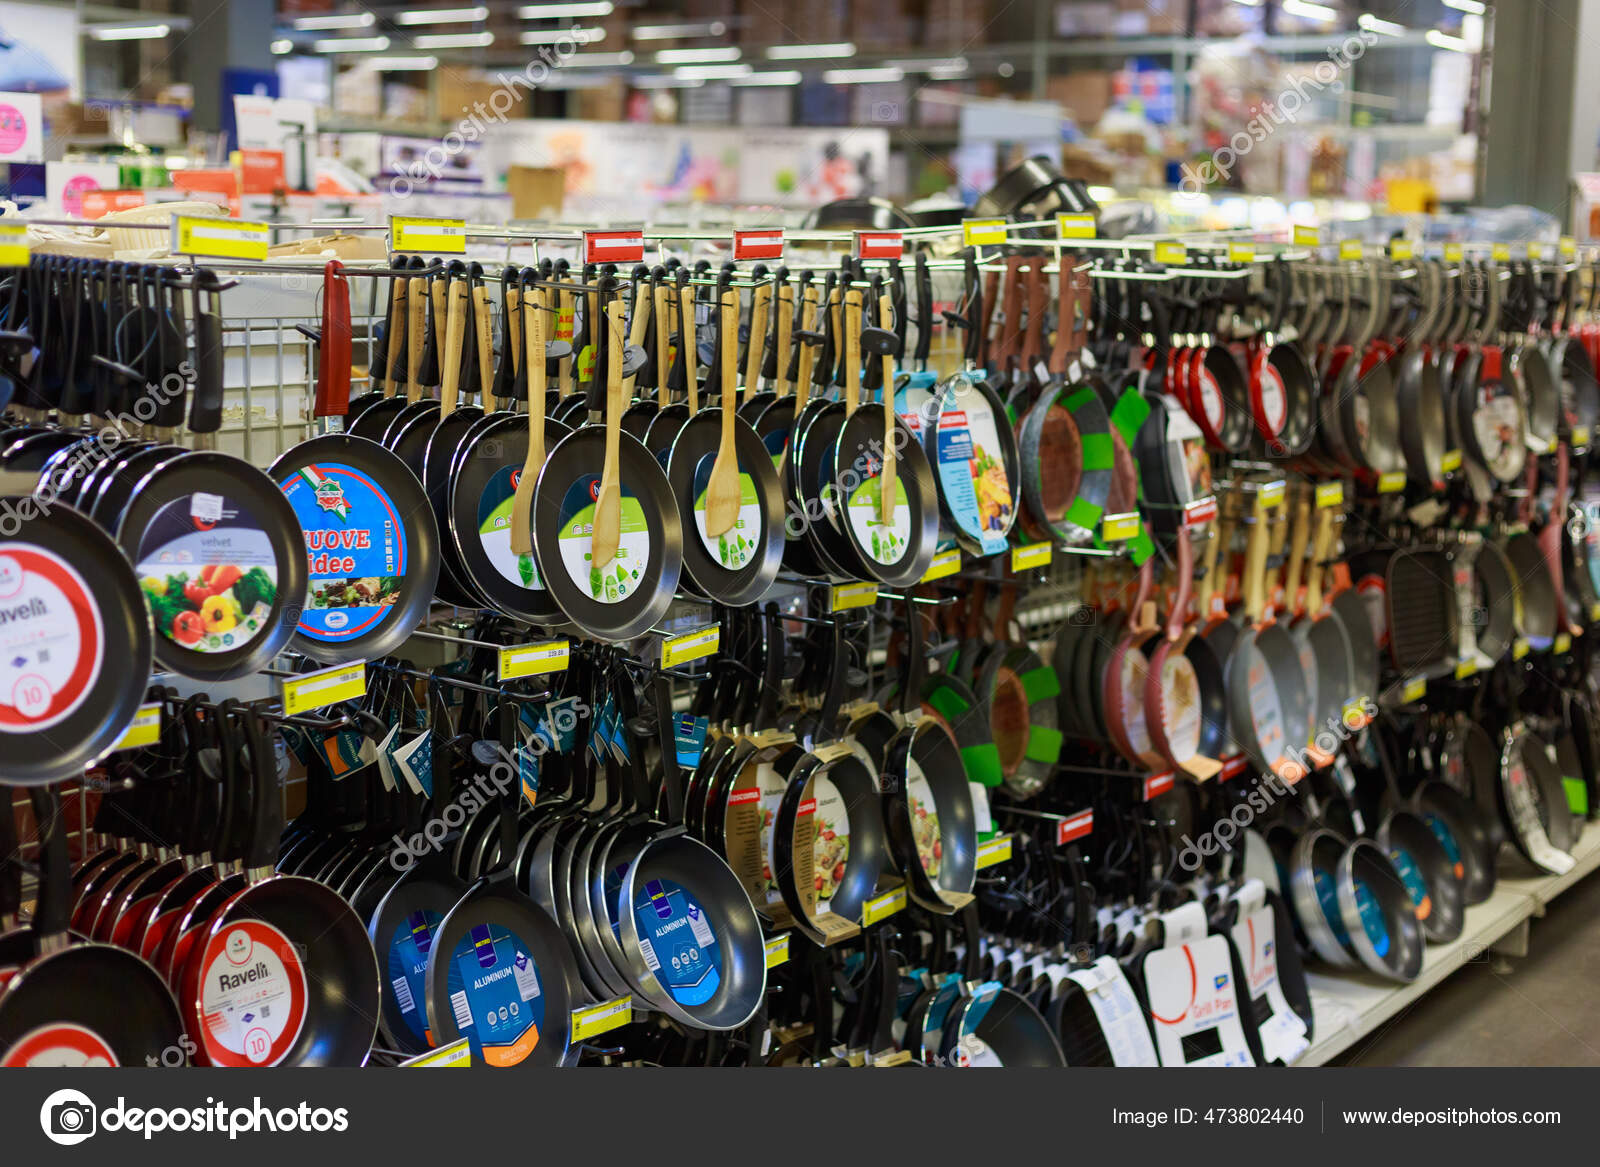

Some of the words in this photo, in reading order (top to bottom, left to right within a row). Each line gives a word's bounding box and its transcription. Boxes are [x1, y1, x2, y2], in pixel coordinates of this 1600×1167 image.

[201, 536, 232, 547] velvet
[24, 687, 42, 705] 10
[655, 917, 688, 938] ALUMINIUM
[474, 966, 513, 990] ALUMINIUM
[251, 1038, 265, 1055] 10
